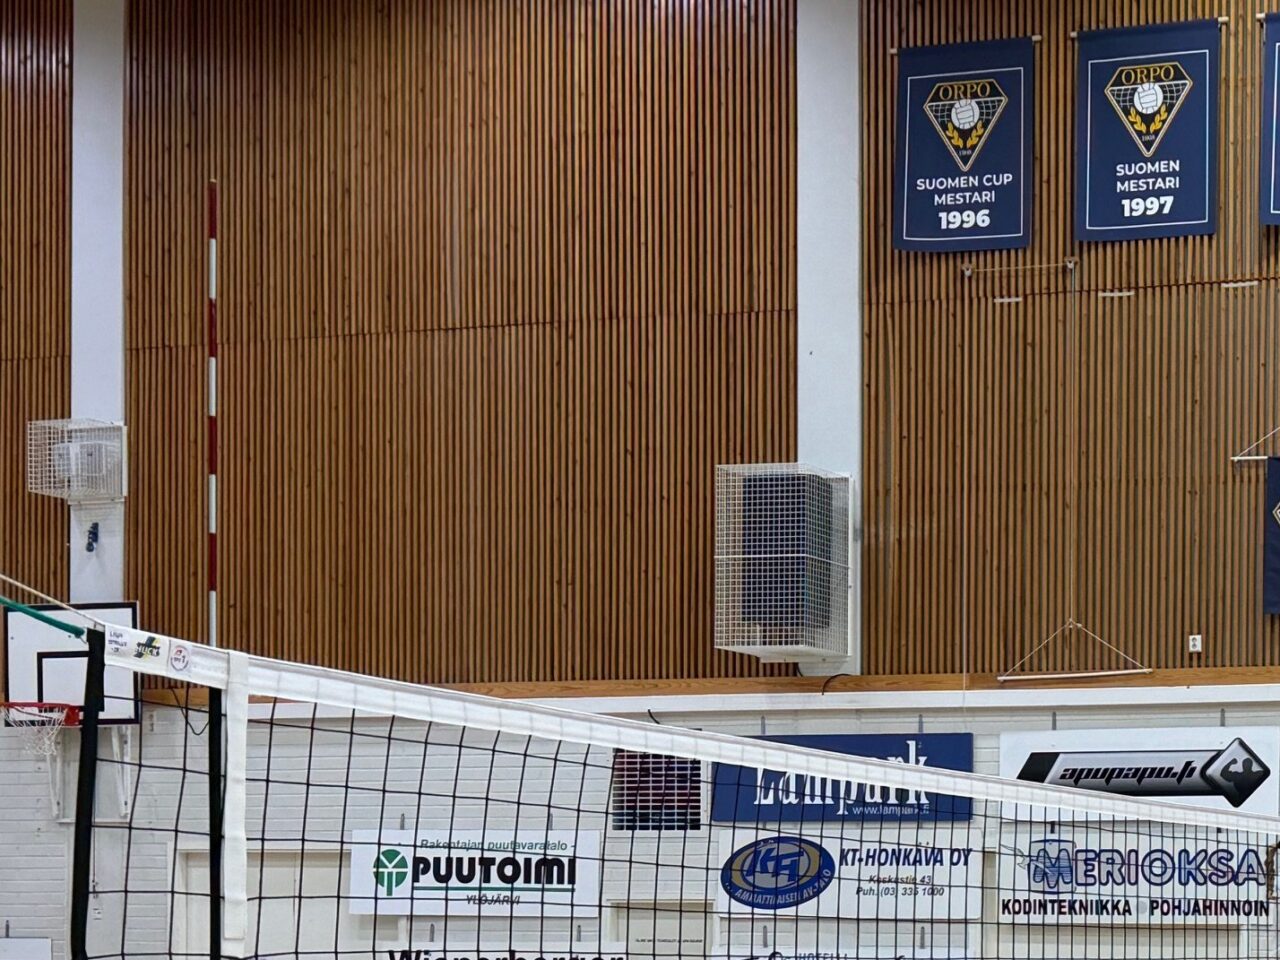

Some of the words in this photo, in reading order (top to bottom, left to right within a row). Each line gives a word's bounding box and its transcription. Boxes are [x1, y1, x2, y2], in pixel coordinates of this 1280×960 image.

[1121, 65, 1175, 85] ORPO
[938, 81, 991, 100] ORPO
[1115, 160, 1180, 176] SUOMEN
[916, 175, 979, 191] SUOMEN
[982, 173, 1013, 187] CUP
[1116, 177, 1180, 193] MESTARI
[934, 190, 995, 206] MESTARI
[1121, 196, 1174, 216] 1997
[938, 209, 991, 229] 1996
[840, 848, 944, 867] KT-HONKAVA
[950, 848, 973, 867] OY
[412, 856, 576, 885] PUUTOIMI
[1032, 848, 1267, 889] MERIOKSA
[922, 887, 945, 896] 1000
[1001, 898, 1133, 916] KODINTEKNIIKKA
[1150, 899, 1270, 917] POHJAHINNOIN
